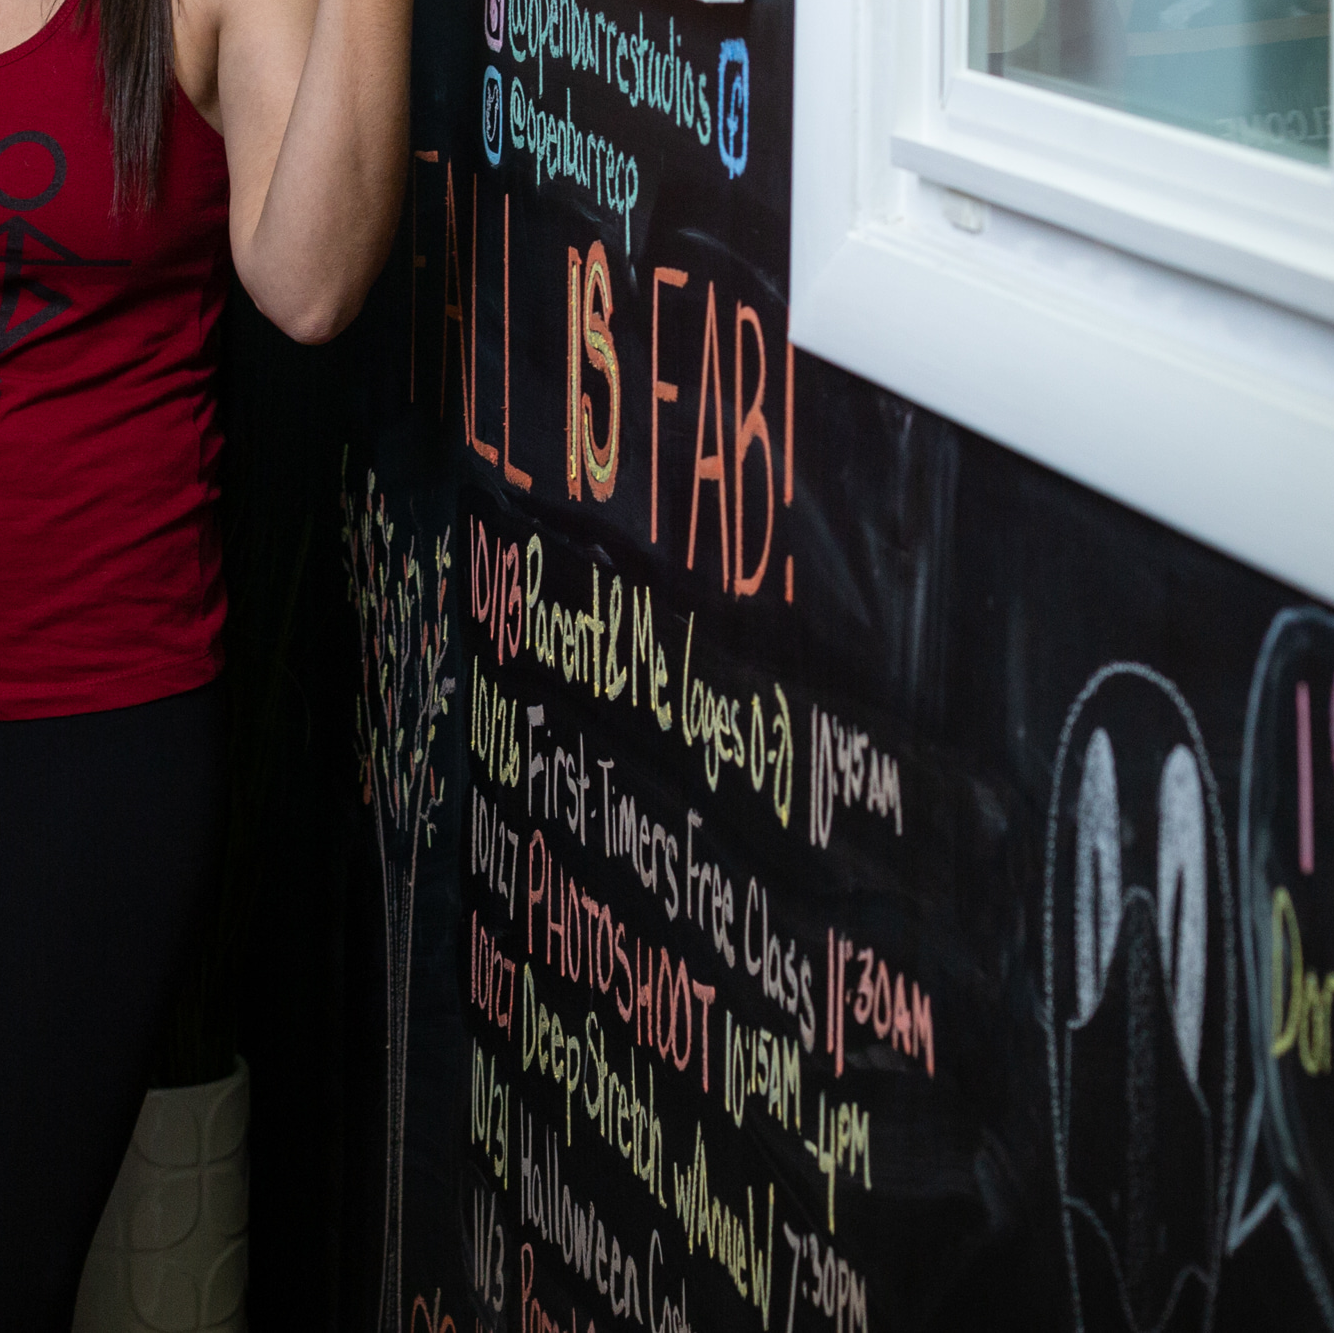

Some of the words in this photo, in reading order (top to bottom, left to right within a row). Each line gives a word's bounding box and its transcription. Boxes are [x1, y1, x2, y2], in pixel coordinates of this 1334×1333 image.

[509, 76, 640, 258] @openbarrecp
[567, 239, 621, 504] IS
[649, 265, 795, 606] FAB!
[470, 513, 523, 667] 10/13
[525, 532, 605, 699] Parent
[630, 584, 673, 733] Me
[681, 610, 745, 794] (ages
[1294, 679, 1315, 876] I
[470, 783, 520, 922] 10/27
[527, 828, 717, 1095] PHOTOSHOOT
[470, 909, 516, 1043] 10/27
[521, 960, 582, 1148] Deep
[583, 1010, 668, 1209] Stretch
[685, 805, 737, 970] Free
[743, 874, 816, 1055] Class
[469, 1036, 511, 1192] 10/31
[519, 1096, 644, 1326] Halloween
